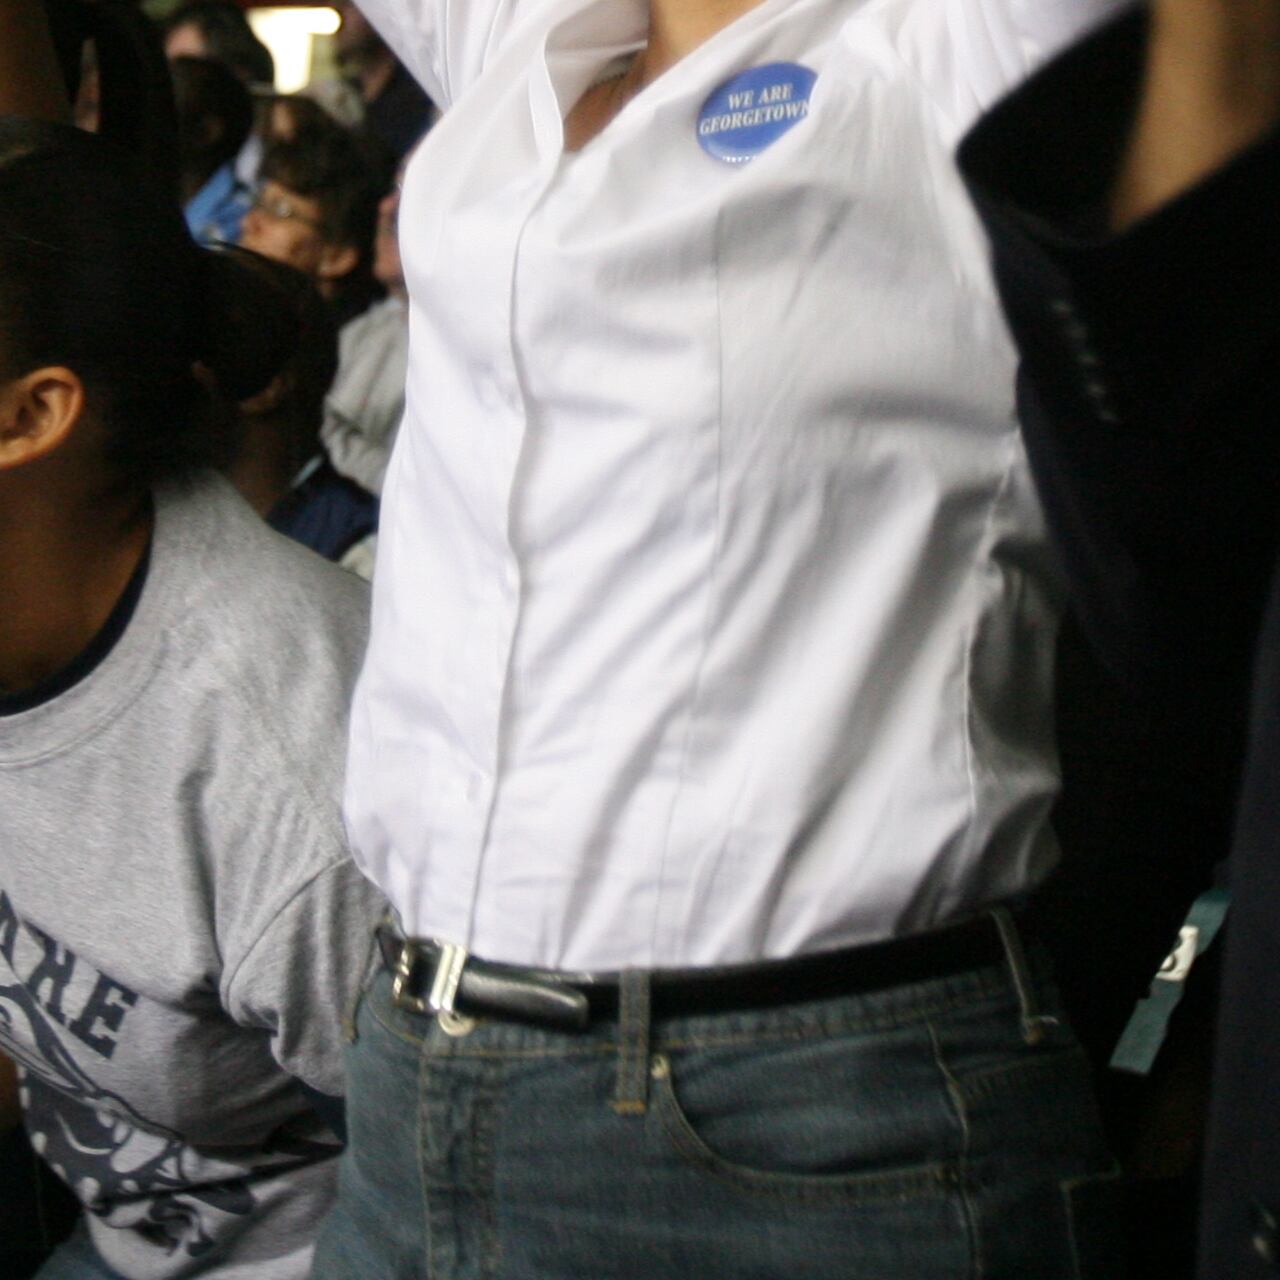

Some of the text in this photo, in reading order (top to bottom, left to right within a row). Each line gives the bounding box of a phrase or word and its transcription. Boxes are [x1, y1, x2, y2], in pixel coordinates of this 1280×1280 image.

[728, 83, 794, 110] WE ARE
[699, 99, 810, 136] GEORGETOWN
